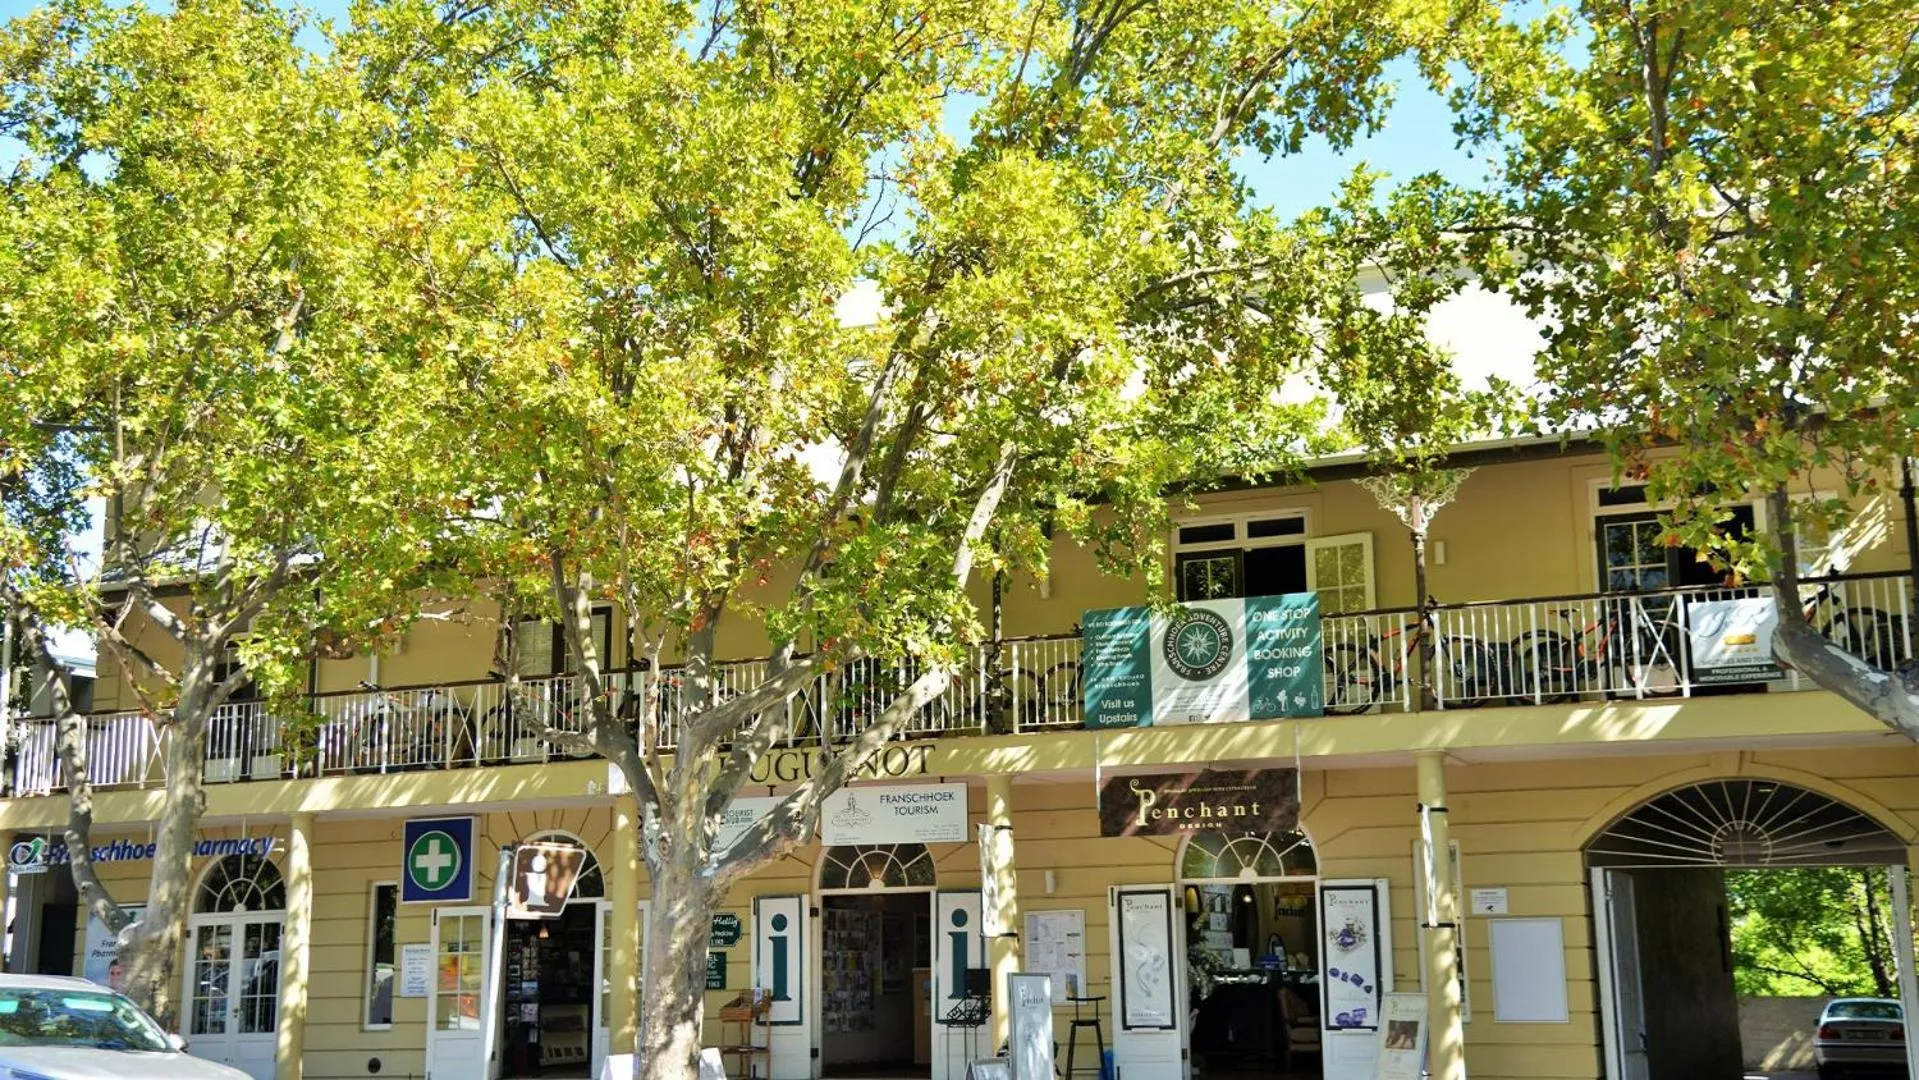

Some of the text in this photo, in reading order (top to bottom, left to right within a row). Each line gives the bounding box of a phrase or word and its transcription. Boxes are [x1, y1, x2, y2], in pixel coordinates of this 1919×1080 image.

[1253, 607, 1310, 622] ONE STOP
[1257, 627, 1308, 641] ACTIVITY
[1253, 646, 1312, 660] BOOKING
[1267, 665, 1300, 679] SHOP
[1101, 699, 1135, 709] Visit us
[1099, 713, 1138, 724] Upstairs
[880, 792, 955, 804] FRANSCHHOEK
[1130, 778, 1261, 826] Penchant
[894, 805, 939, 816] TOURISM
